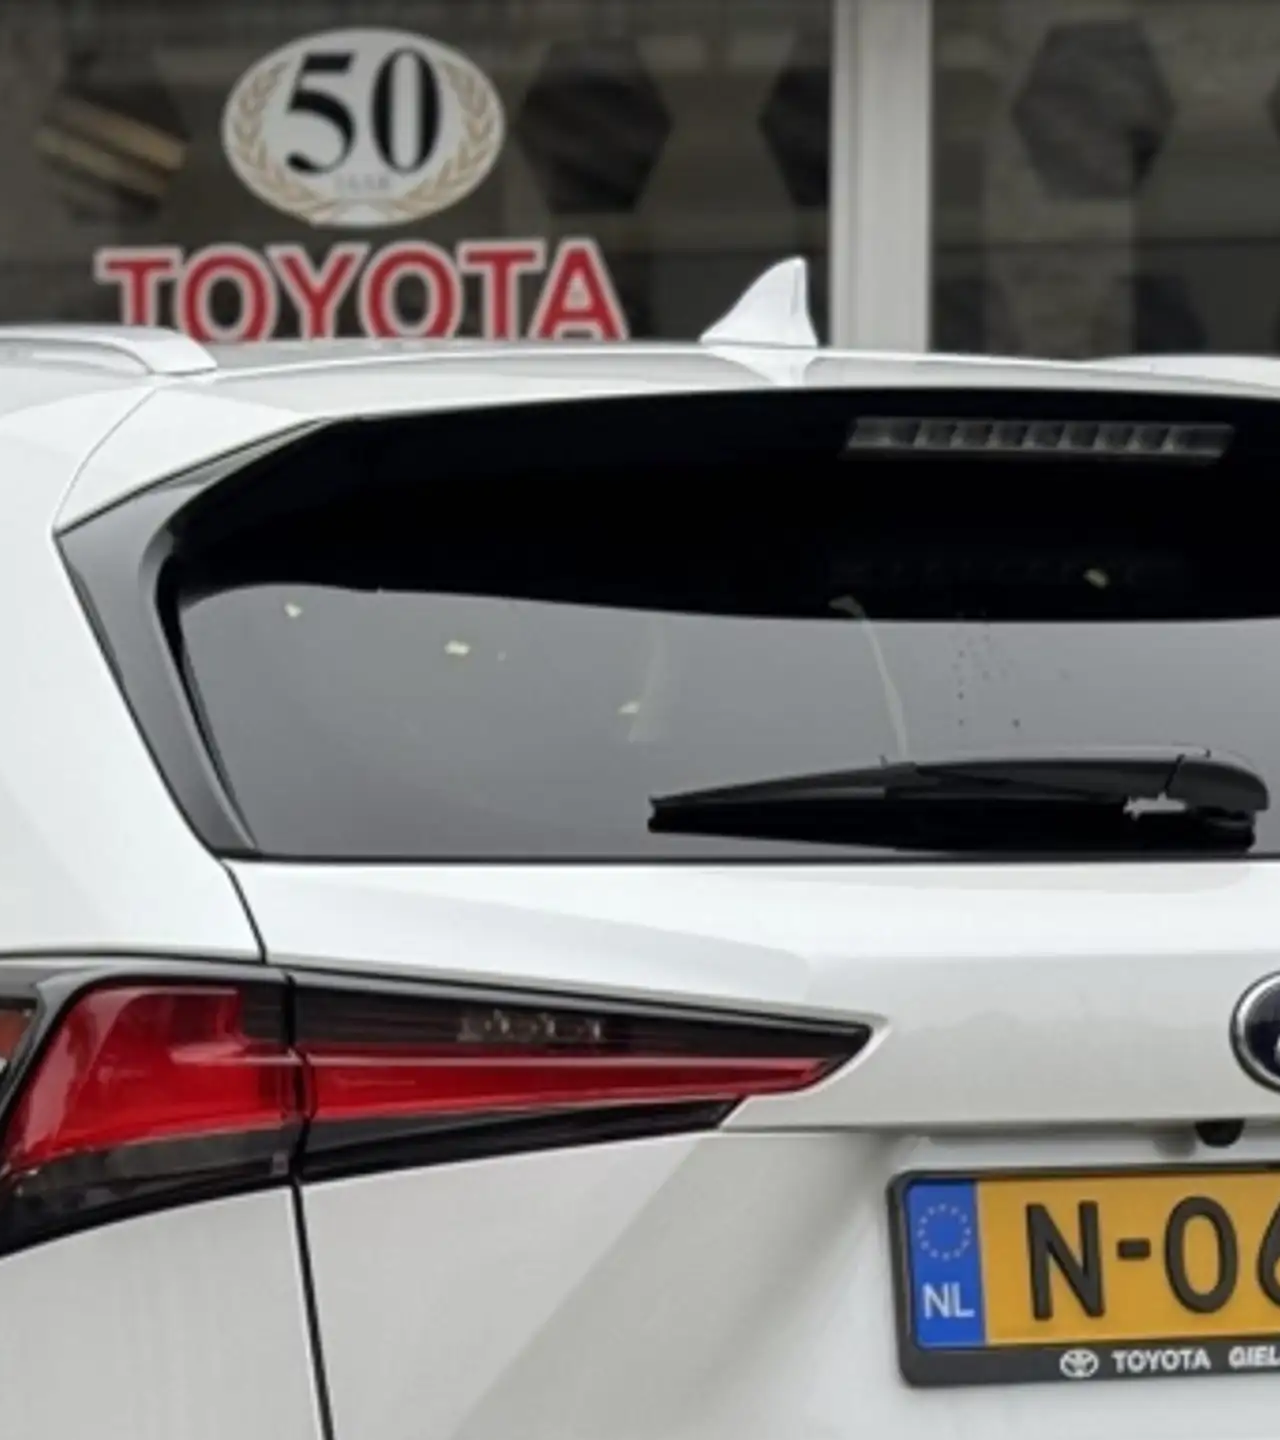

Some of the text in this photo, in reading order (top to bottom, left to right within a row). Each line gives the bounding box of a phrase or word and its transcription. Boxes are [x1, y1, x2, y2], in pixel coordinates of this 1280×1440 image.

[287, 47, 442, 176] 50
[98, 240, 626, 341] TOYOTA
[922, 1282, 975, 1319] NL
[1111, 1347, 1211, 1373] TOYOTA
